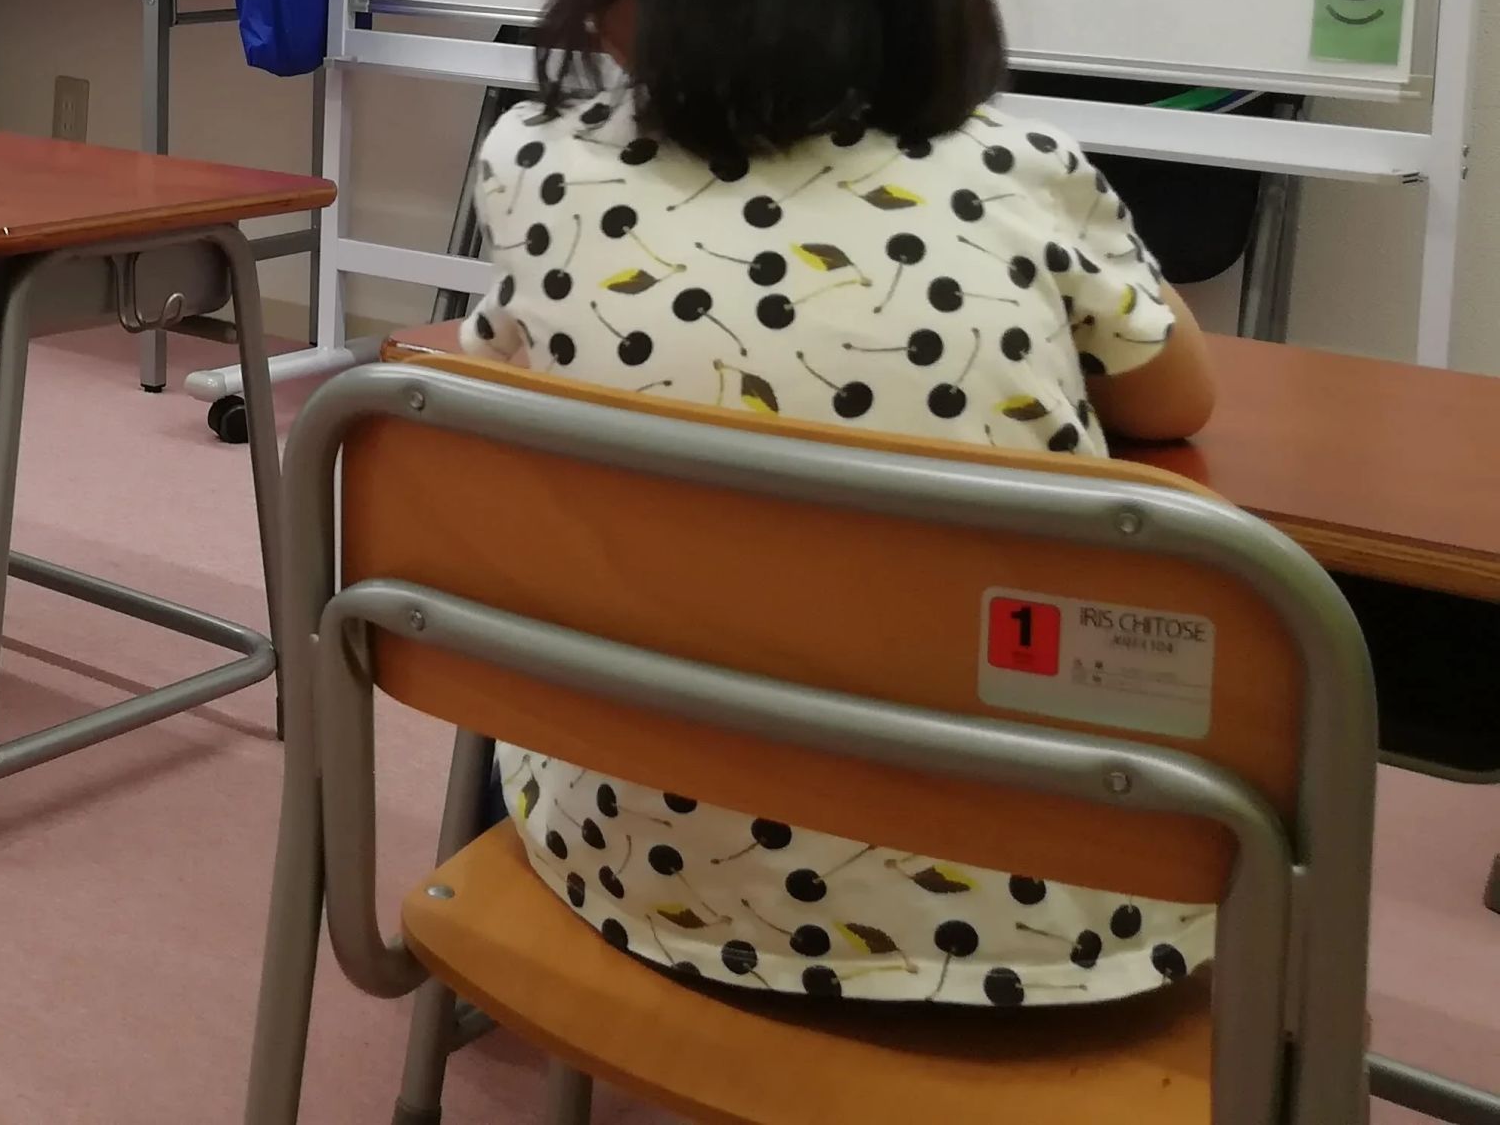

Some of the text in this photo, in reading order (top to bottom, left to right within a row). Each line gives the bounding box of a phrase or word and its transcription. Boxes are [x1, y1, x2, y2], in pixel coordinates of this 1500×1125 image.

[1010, 606, 1206, 648] 1 IRIS CHITOSE
